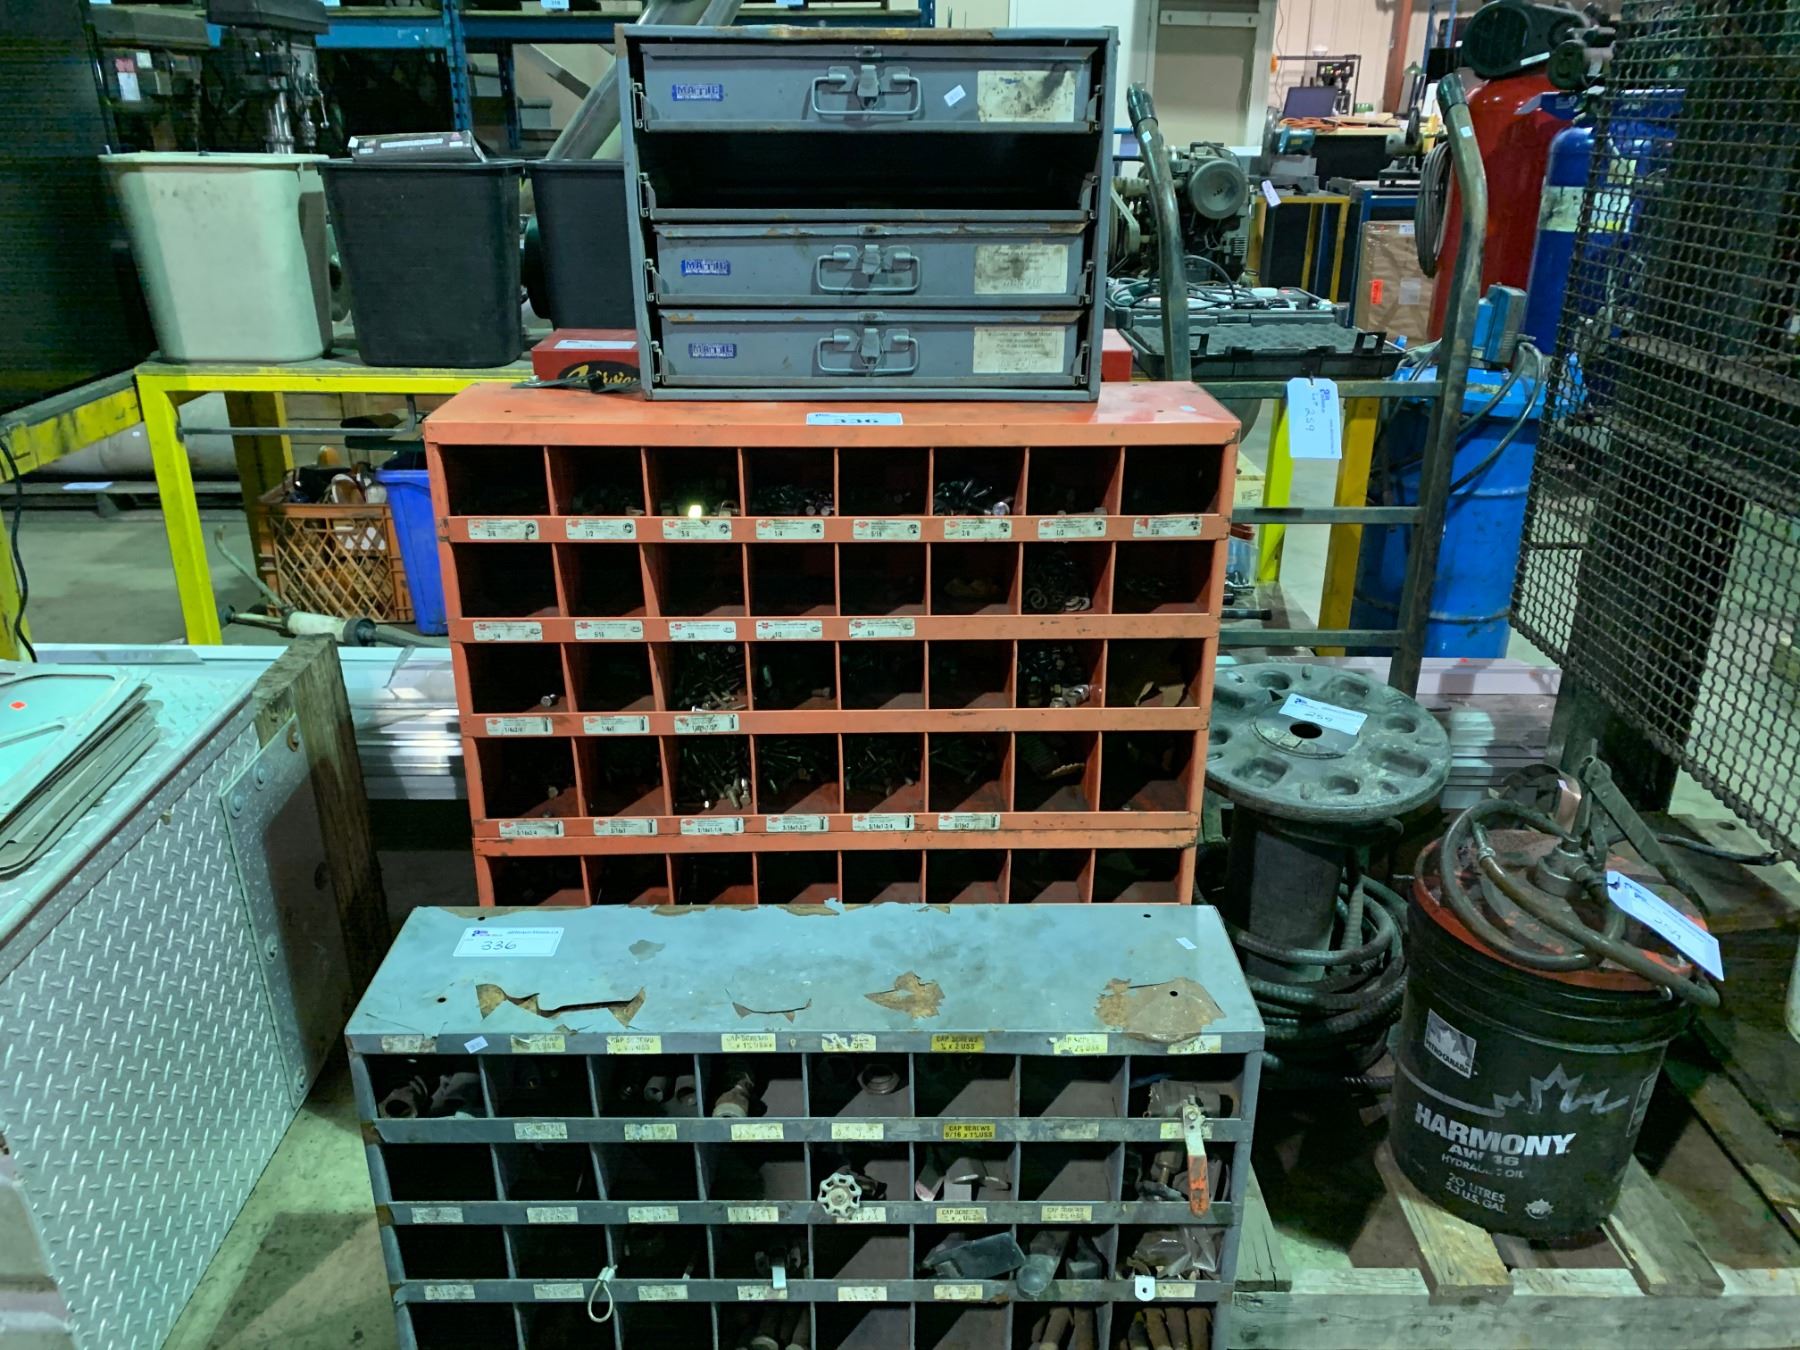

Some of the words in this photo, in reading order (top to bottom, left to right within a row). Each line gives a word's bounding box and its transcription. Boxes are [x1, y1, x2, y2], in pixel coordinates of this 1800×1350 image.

[480, 940, 517, 951] 336
[1415, 1102, 1576, 1156] HARMONY
[1448, 1145, 1485, 1160] AW
[1504, 1170, 1525, 1179] OIL
[1448, 1172, 1466, 1188] 20
[1469, 1182, 1506, 1204] LITRES
